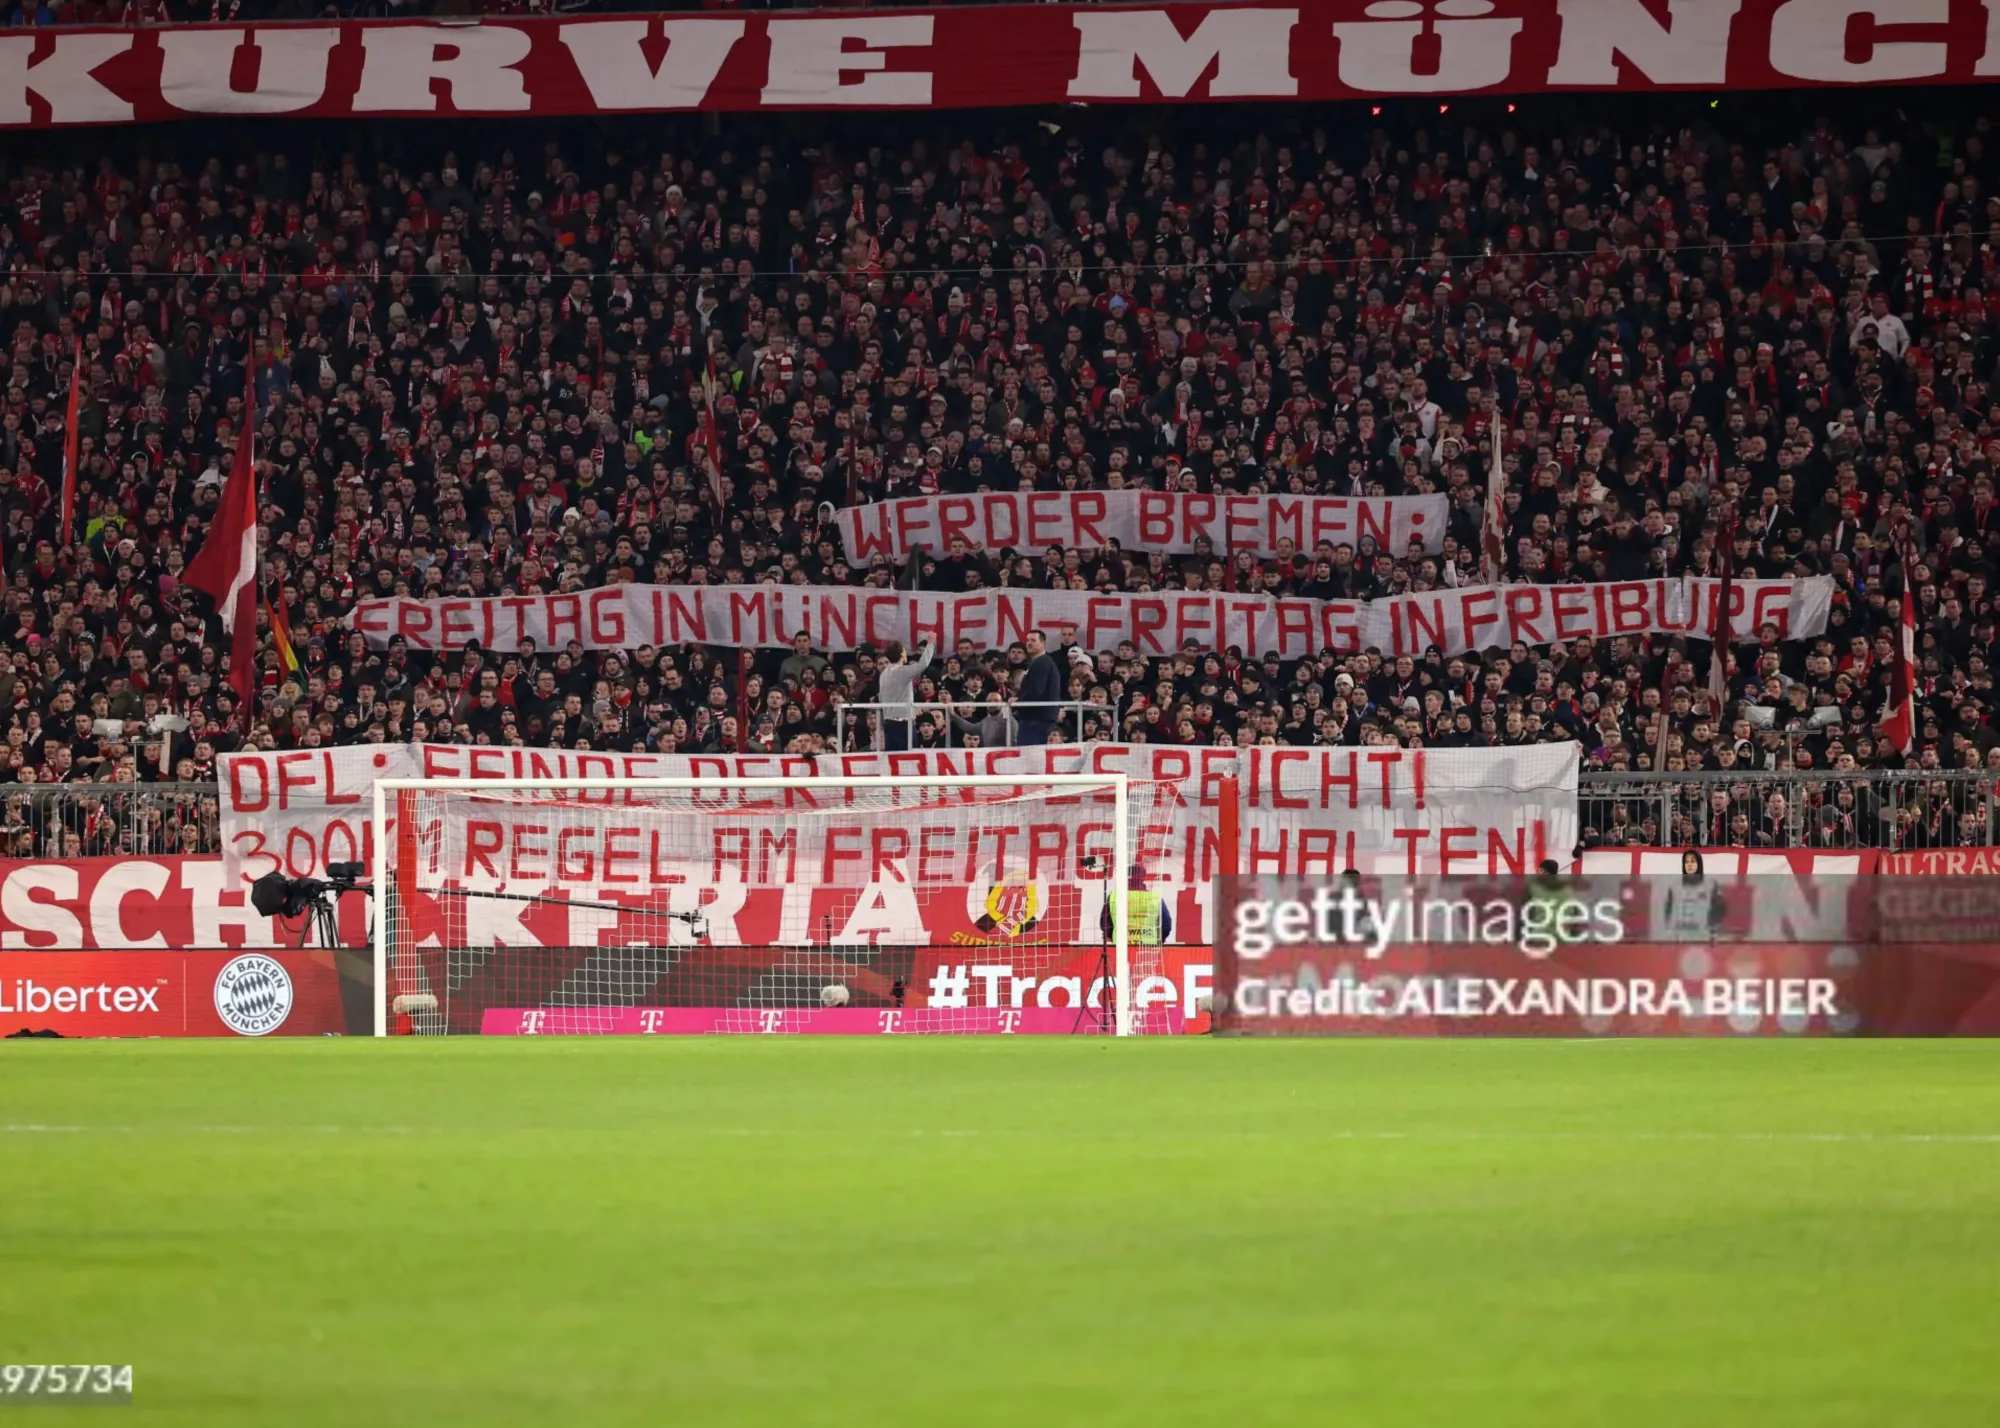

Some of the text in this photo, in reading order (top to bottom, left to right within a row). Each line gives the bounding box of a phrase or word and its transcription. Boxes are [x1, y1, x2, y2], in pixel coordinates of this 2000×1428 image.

[853, 492, 1106, 558] WERDER
[354, 588, 625, 648] FREITAG
[653, 590, 701, 646] IN
[1391, 601, 1446, 656] IN
[1463, 581, 1792, 650] FREIBURG
[1153, 749, 1426, 810] REICHT!
[465, 820, 686, 883] REGEL
[713, 827, 798, 883] AM
[823, 822, 1114, 884] FREITAG
[222, 959, 286, 989] FC BAYERN
